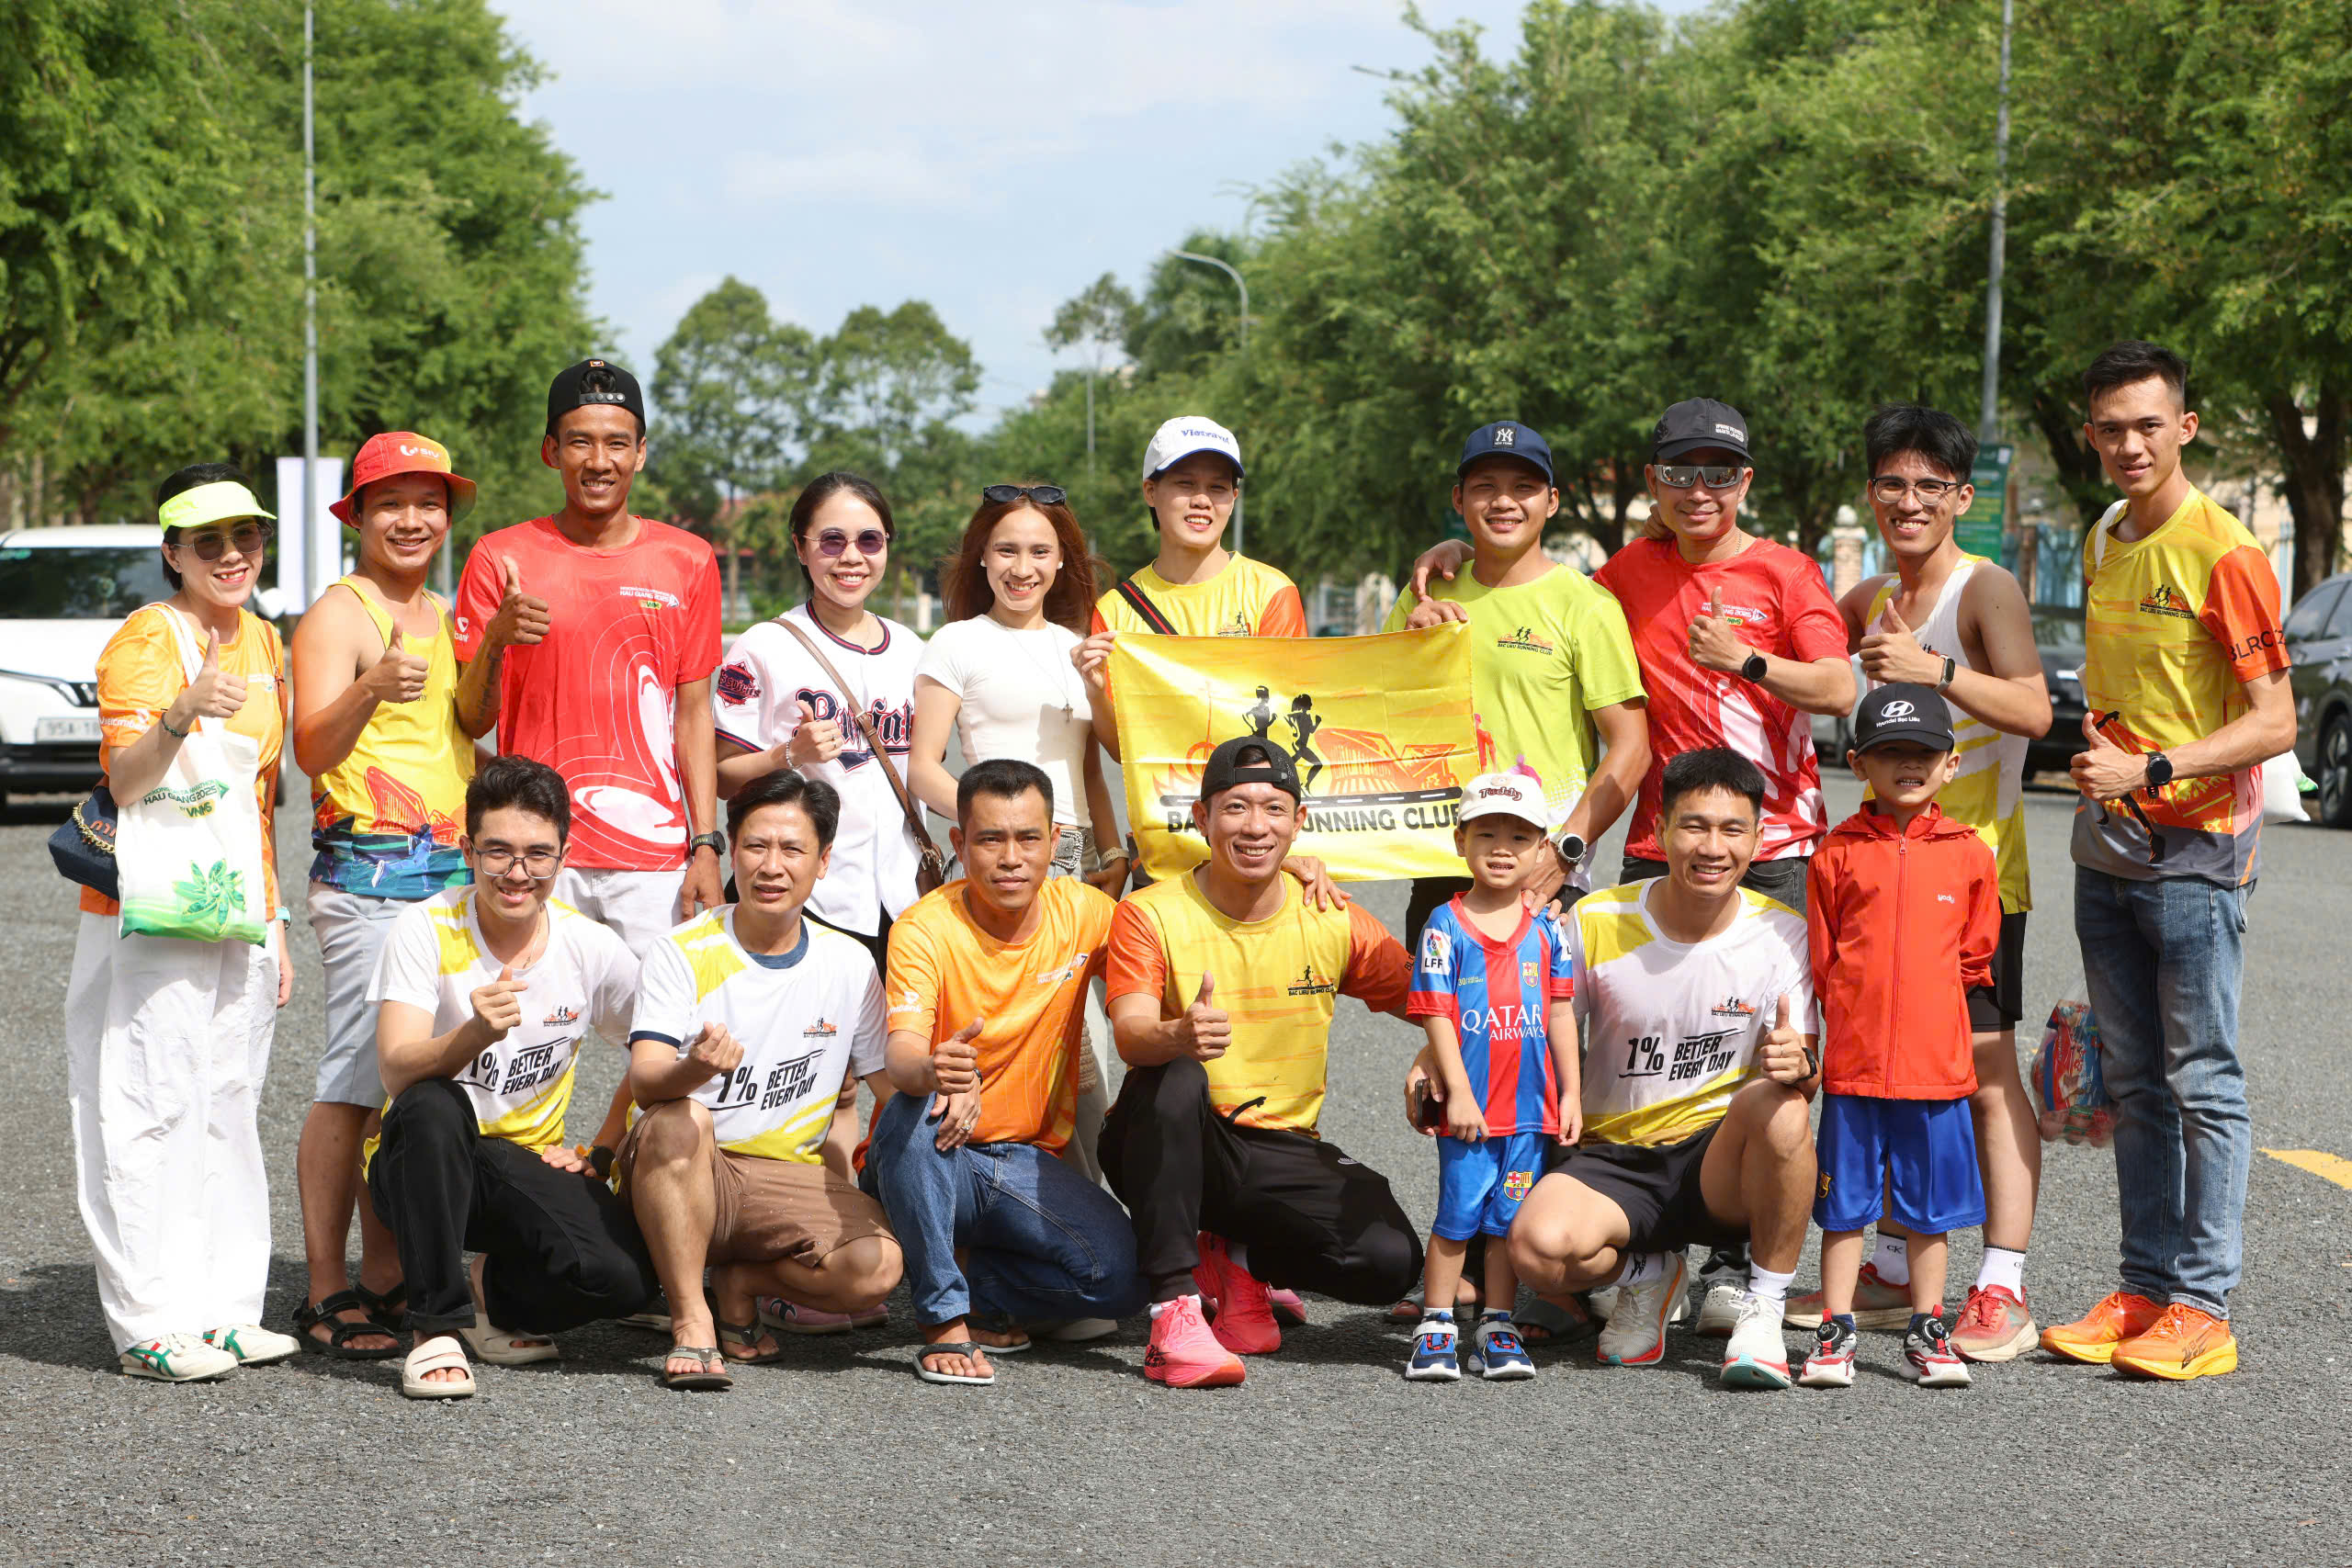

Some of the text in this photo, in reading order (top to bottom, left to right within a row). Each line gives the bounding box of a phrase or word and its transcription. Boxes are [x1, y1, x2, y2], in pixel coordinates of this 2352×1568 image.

[1876, 717, 1897, 728] Hyundai
[144, 792, 167, 806] HAU
[1479, 786, 1522, 802] Teddy
[186, 802, 212, 818] VNMS
[1167, 810, 1200, 833] BA
[1300, 808, 1396, 833] UNNING
[1462, 1003, 1544, 1035] QATAR
[1488, 1025, 1545, 1042] AIRWAYS
[507, 1045, 554, 1078] BETTER
[1627, 1035, 1724, 1071] 1% BETTER
[1668, 1050, 1736, 1082] EVERY DAY
[501, 1057, 563, 1096] EVERY DAY
[717, 1057, 810, 1103] 1% BETTER
[761, 1072, 818, 1111] EVERY DAY
[1887, 1245, 1904, 1255] CK
